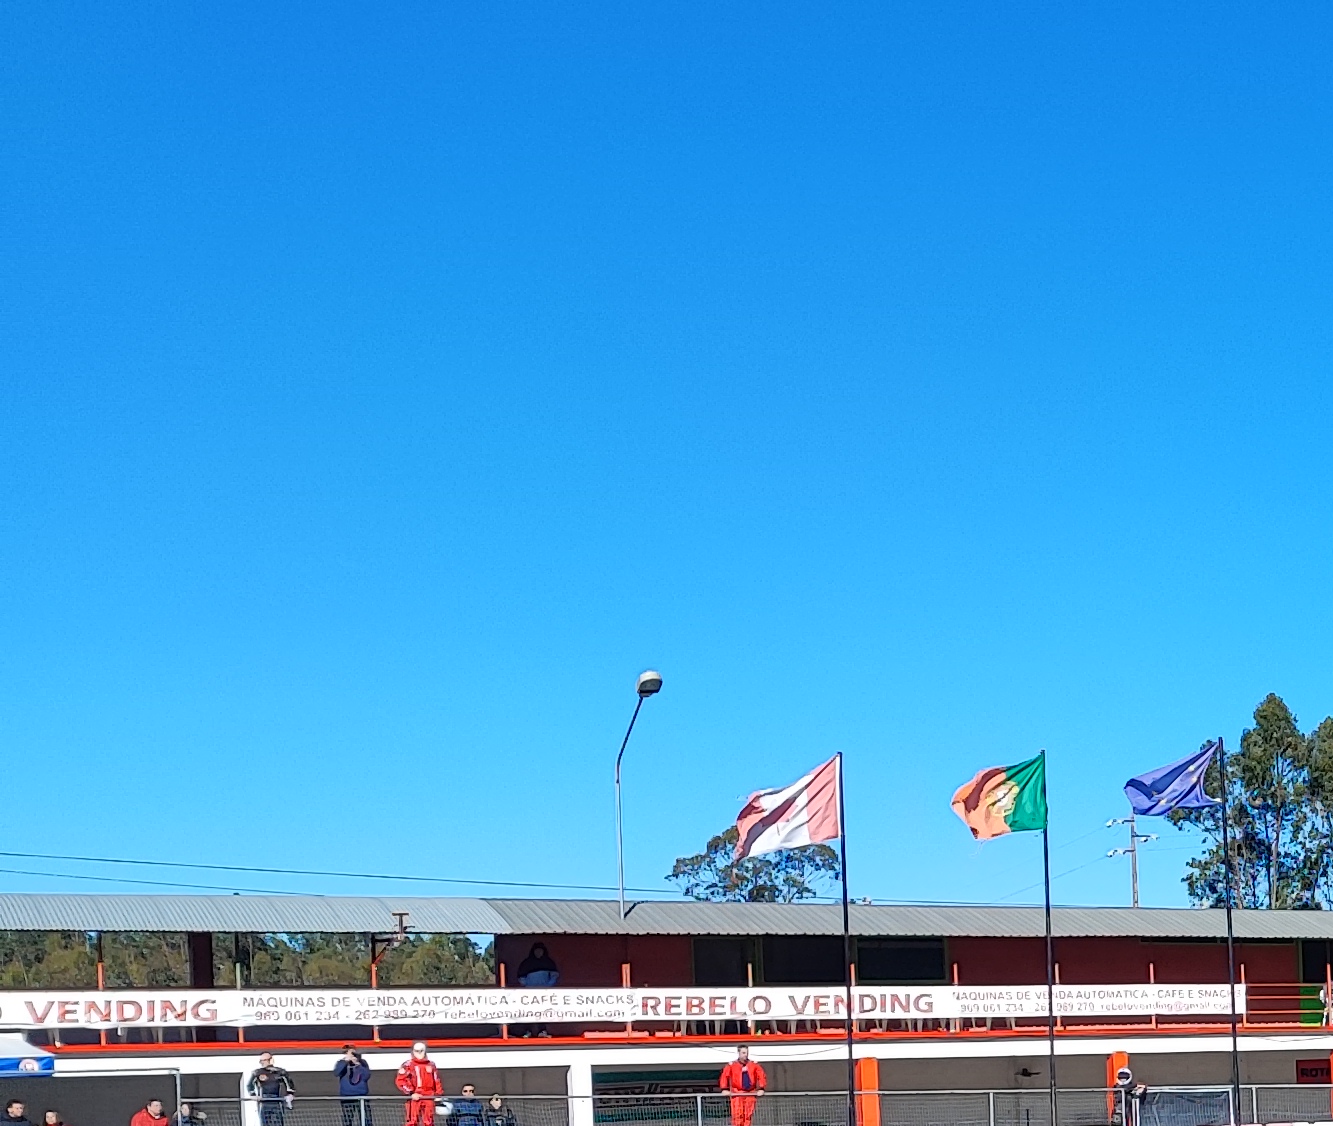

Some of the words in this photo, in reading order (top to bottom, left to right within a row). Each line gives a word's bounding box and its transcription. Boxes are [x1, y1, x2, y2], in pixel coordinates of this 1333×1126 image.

[331, 997, 350, 1007] DE
[356, 996, 408, 1007] VENDA
[563, 995, 571, 1005] E
[576, 994, 634, 1005] SNACKS
[641, 995, 772, 1016] REBELO
[788, 993, 934, 1015] VENDING
[1016, 991, 1031, 1000] DE
[24, 999, 218, 1023] VENDING
